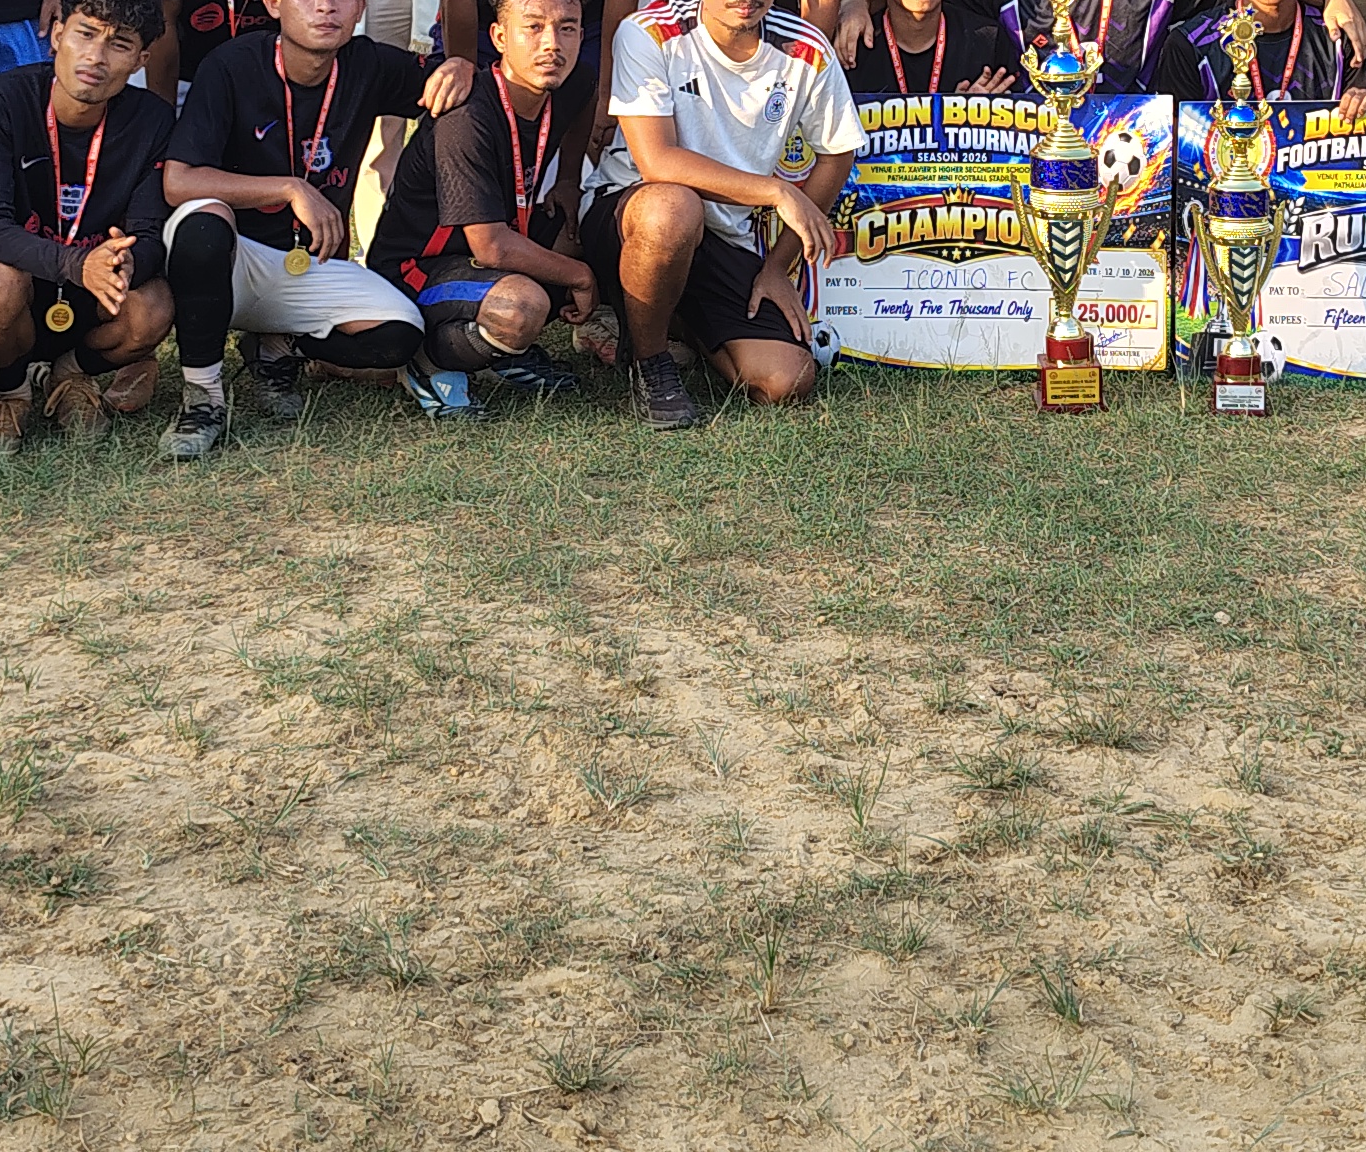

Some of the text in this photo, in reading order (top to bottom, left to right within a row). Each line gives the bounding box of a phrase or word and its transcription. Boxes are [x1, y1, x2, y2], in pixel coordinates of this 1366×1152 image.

[858, 95, 1059, 134] DON BOSCO
[917, 152, 988, 163] SEASON 2026
[939, 166, 963, 174] HIGHER
[964, 166, 1006, 174] SECONDARY
[1006, 166, 1031, 174] SCHOO
[954, 174, 988, 182] FOOTBALL
[855, 205, 1032, 263] CHAMPIO
[825, 278, 842, 287] PAY
[901, 268, 1035, 291] ICONIQ FC
[1268, 286, 1285, 296] PAY
[873, 298, 914, 322] Twenty
[919, 299, 944, 316] Five
[948, 300, 1003, 316] Thousand
[1007, 300, 1035, 323] Only
[1077, 303, 1152, 328] 25,000/-
[1323, 308, 1366, 330] Fifteen
